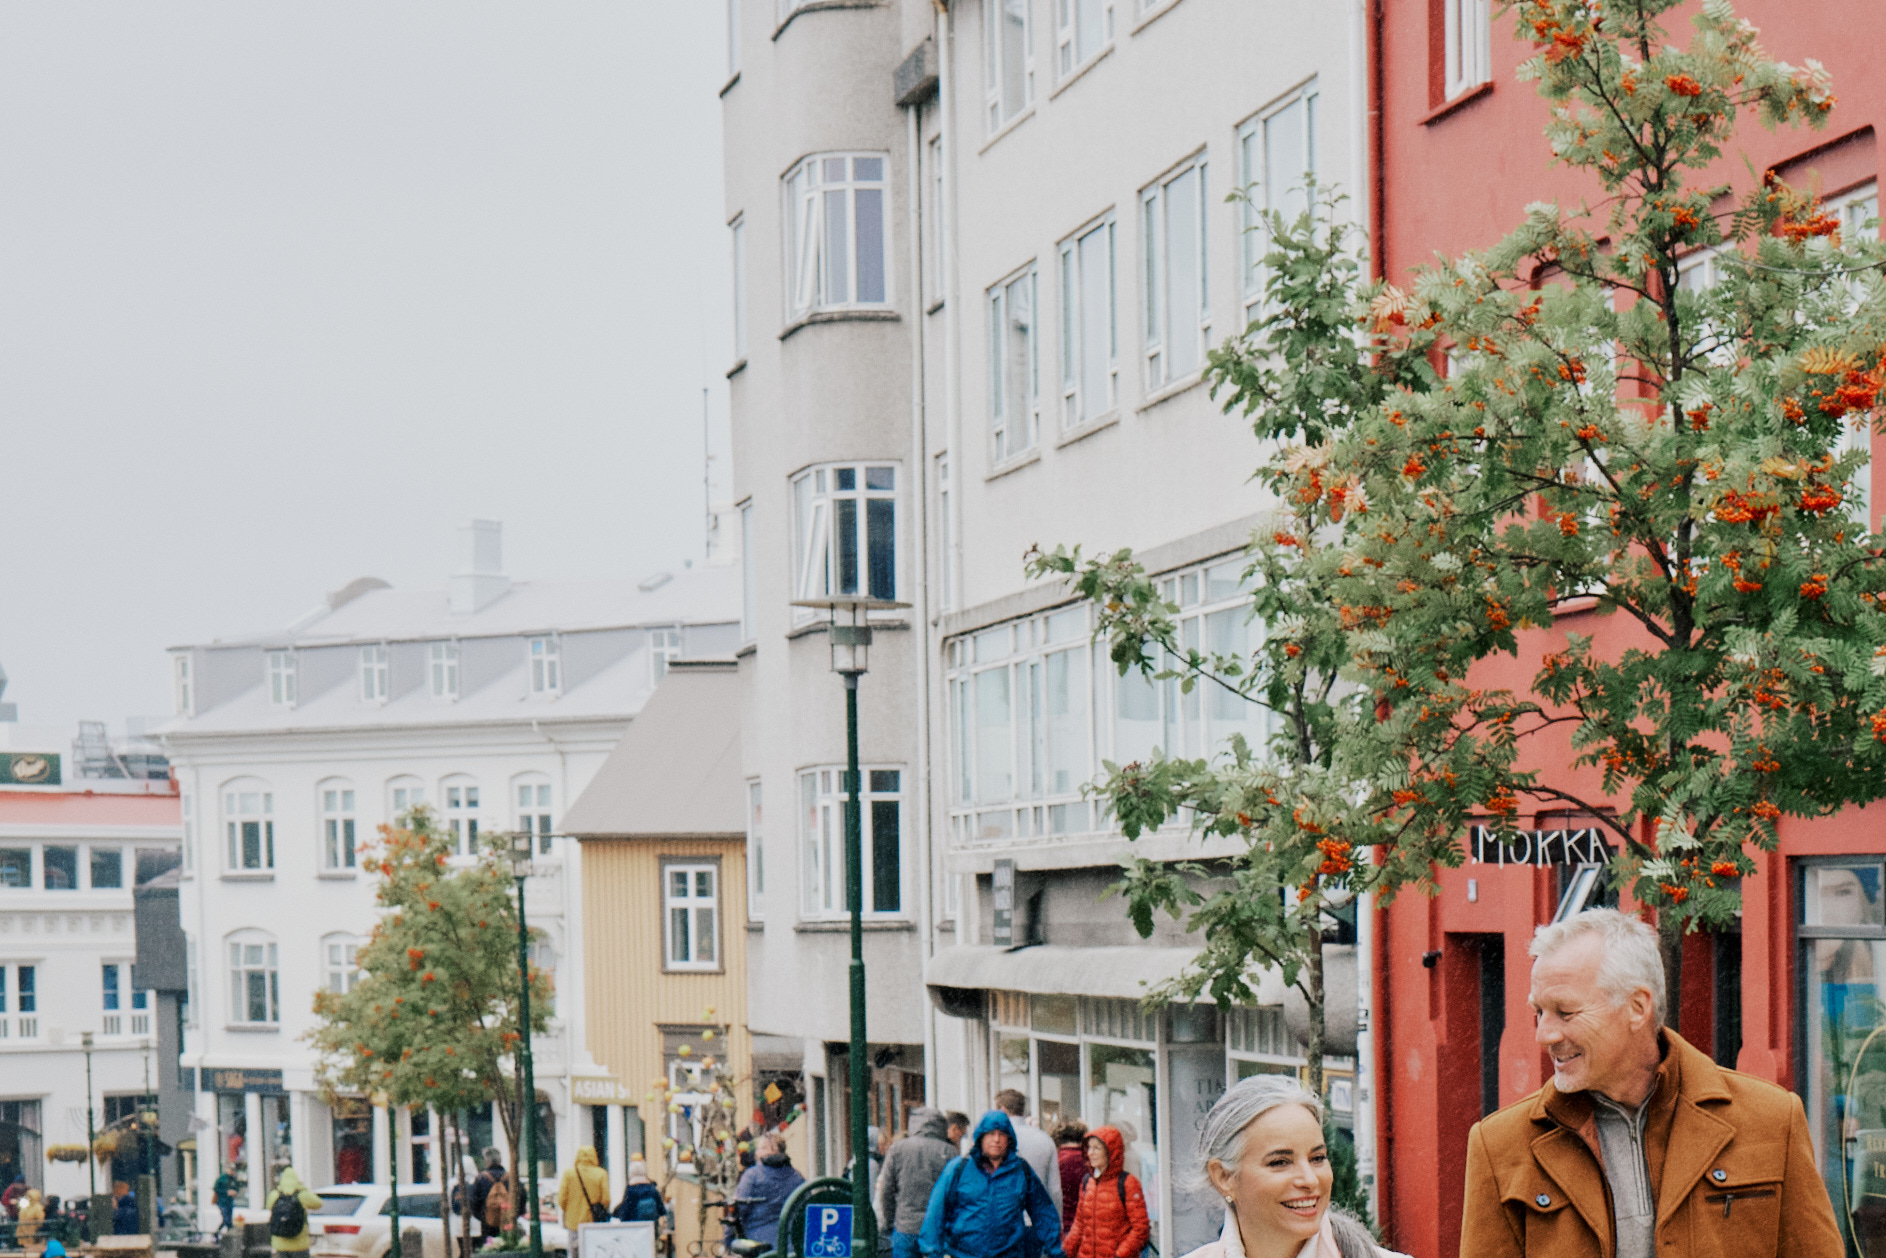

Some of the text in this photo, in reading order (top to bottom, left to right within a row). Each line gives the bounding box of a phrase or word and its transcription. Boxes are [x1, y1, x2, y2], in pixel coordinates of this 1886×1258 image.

[1478, 824, 1610, 869] MOKKA
[574, 1080, 616, 1100] ASIAN
[821, 1208, 839, 1233] P
